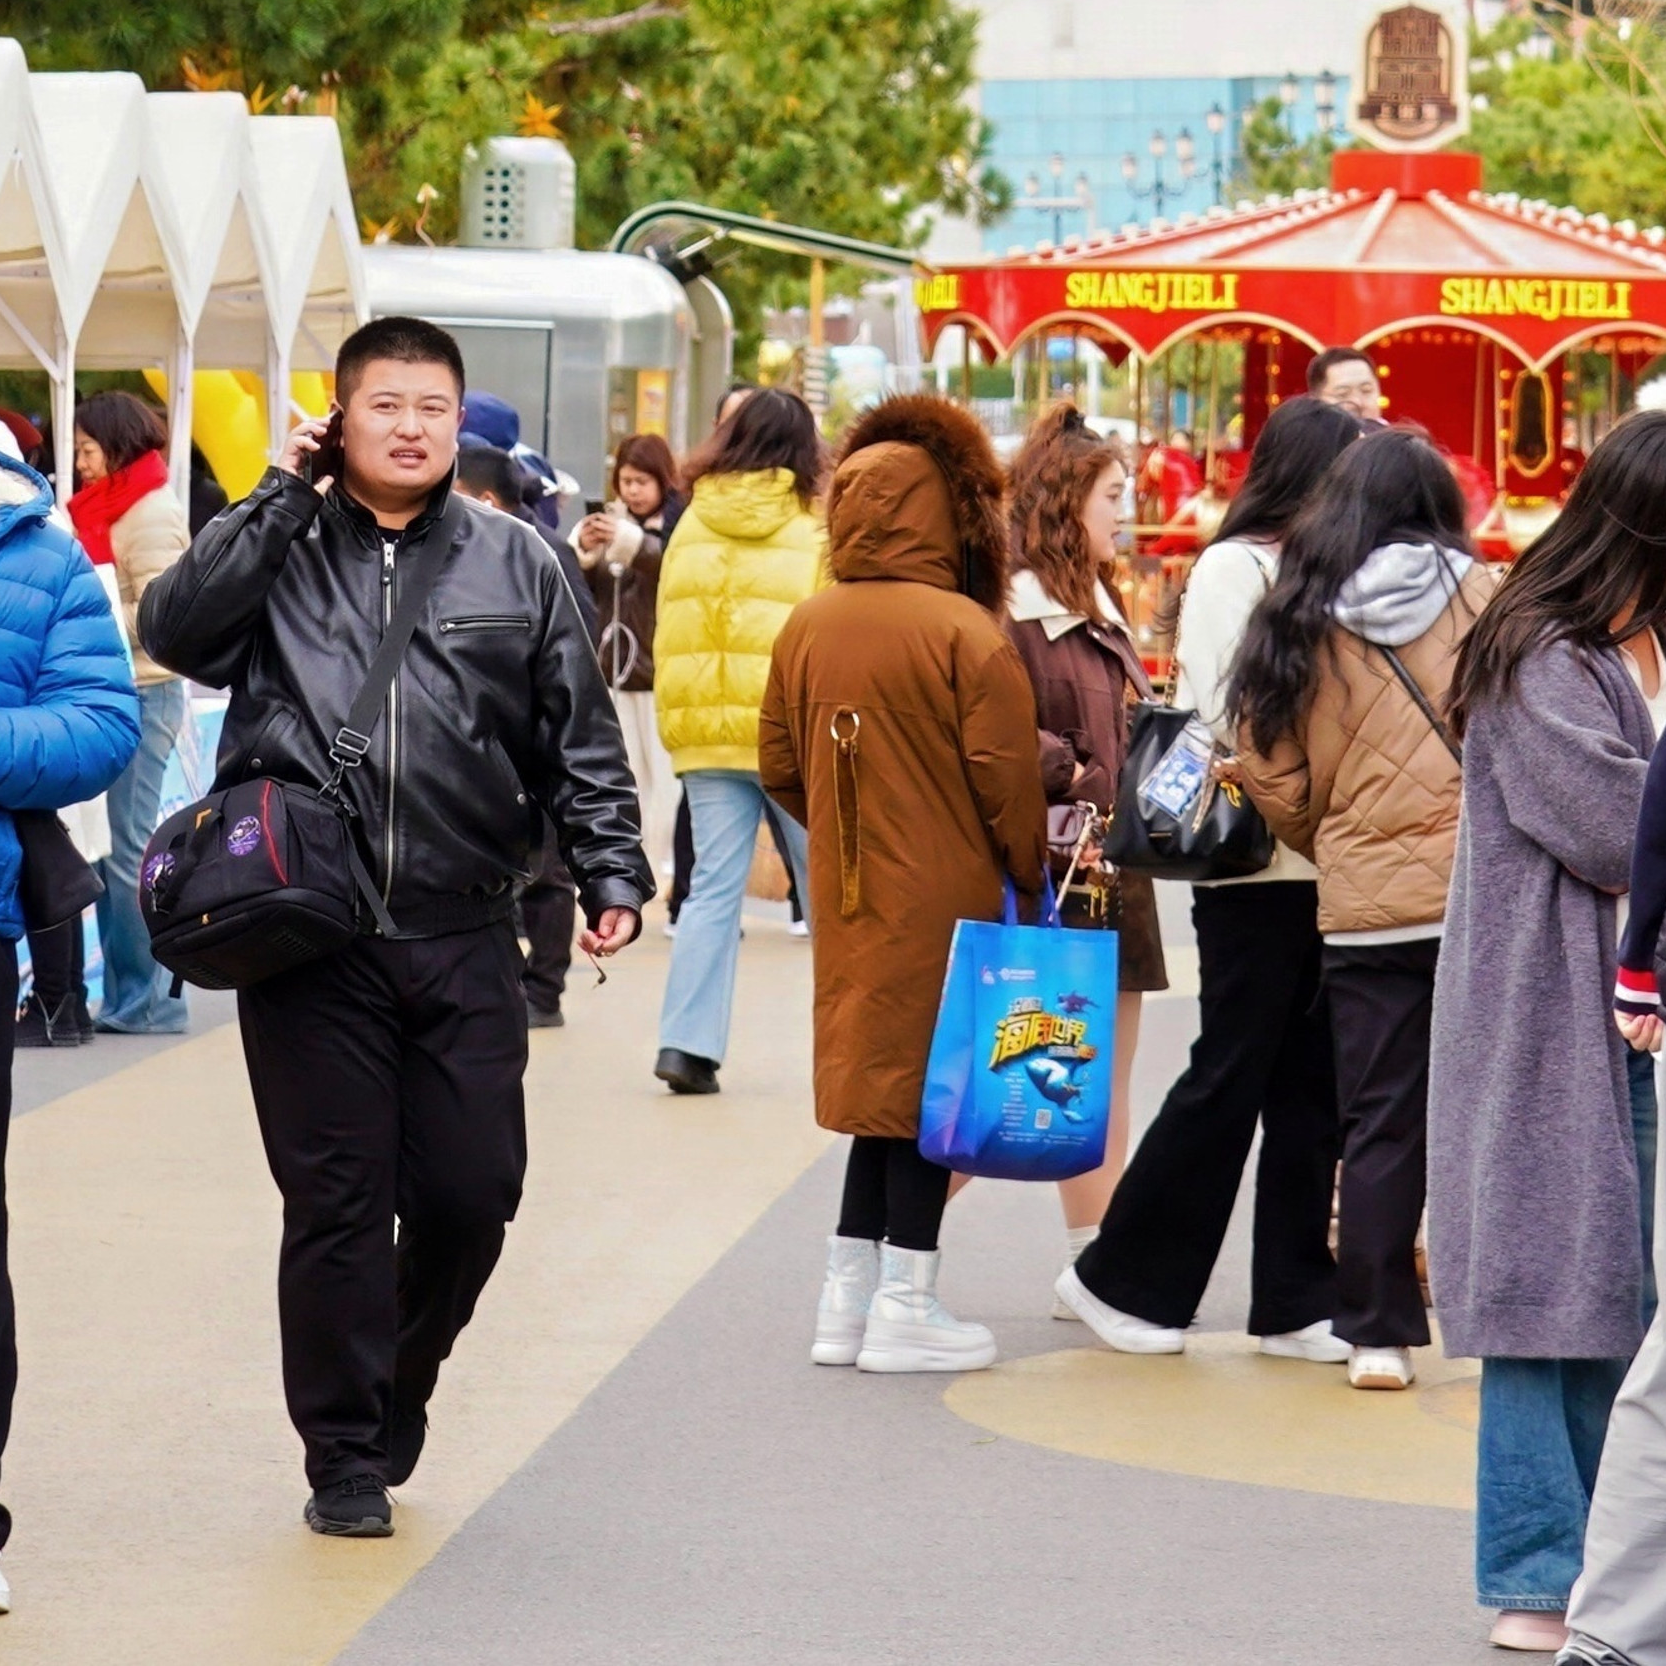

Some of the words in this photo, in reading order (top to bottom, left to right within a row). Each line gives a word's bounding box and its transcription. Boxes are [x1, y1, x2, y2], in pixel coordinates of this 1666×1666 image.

[1065, 271, 1238, 314] SHANGJIELI
[1439, 277, 1632, 322] SHANGJIELI
[988, 1013, 1087, 1070] 海底世界
